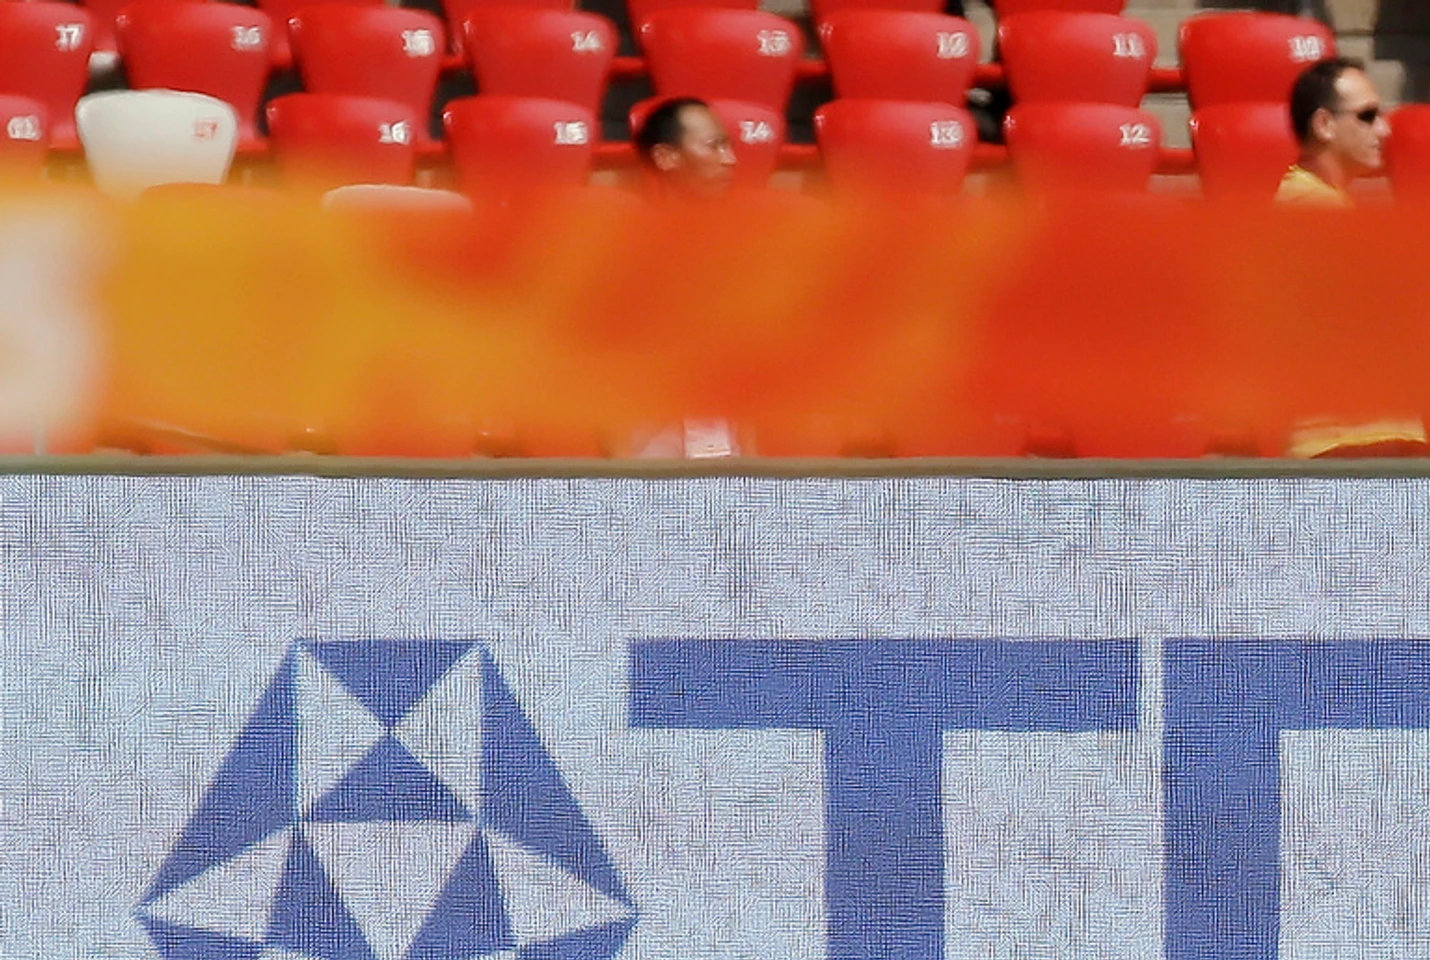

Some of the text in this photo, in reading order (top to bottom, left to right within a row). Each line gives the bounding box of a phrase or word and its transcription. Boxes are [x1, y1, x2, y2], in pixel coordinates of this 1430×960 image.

[55, 25, 84, 49] 17
[571, 30, 600, 51] 14
[936, 33, 967, 58] 12
[1112, 34, 1143, 57] 11
[378, 121, 410, 143] 16
[554, 121, 587, 144] 15
[740, 121, 772, 143] 14
[1119, 123, 1152, 146] 12
